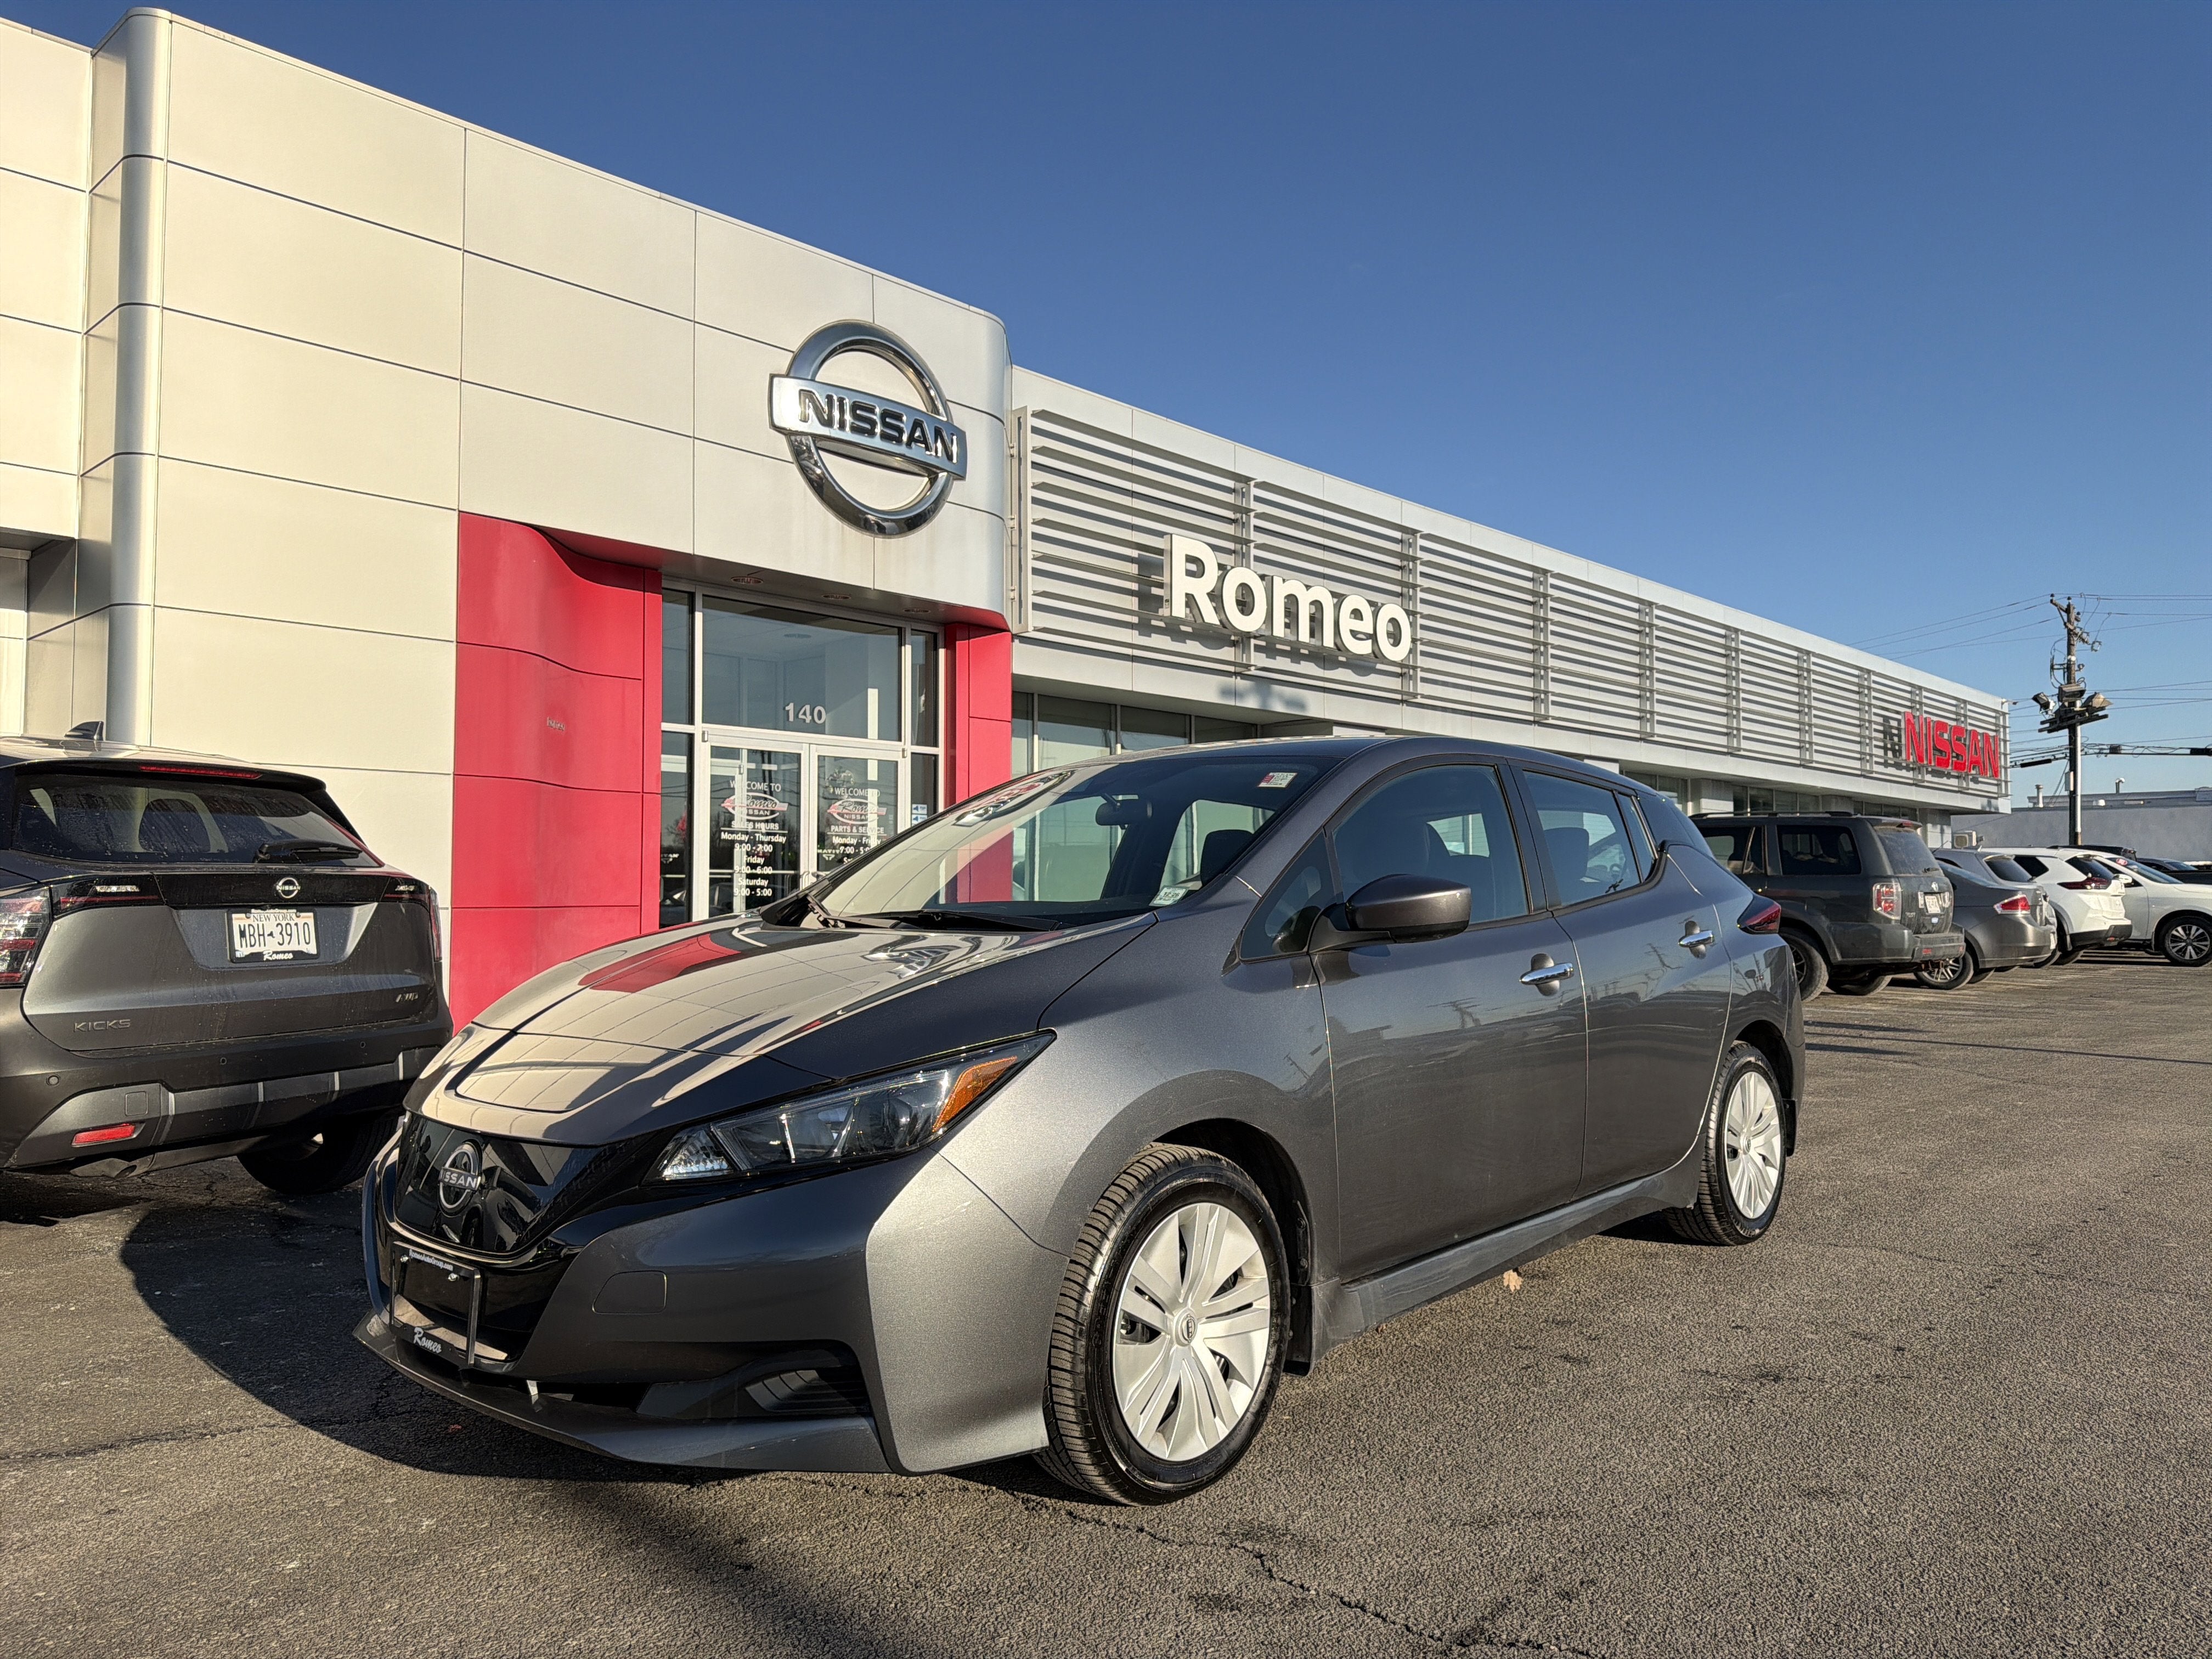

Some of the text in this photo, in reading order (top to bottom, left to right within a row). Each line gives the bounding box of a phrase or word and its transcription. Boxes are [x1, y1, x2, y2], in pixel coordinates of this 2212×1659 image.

[798, 389, 957, 465] NISSAN
[1165, 534, 1411, 661] Romeo
[785, 702, 826, 724] 140
[1905, 712, 2000, 779] NISSAN
[730, 780, 781, 792] WCOME TO
[834, 787, 868, 797] WELCOME
[755, 822, 779, 831] HOURS
[721, 831, 749, 842] Monday
[755, 833, 787, 844] Thursday
[832, 836, 857, 845] Monday
[734, 843, 751, 852] 9:00
[839, 846, 855, 854] 7:00
[860, 847, 870, 855] 5:0
[743, 855, 765, 865] Friday
[734, 865, 751, 874] 9:00
[757, 866, 773, 874] 6:00
[738, 878, 769, 887] Saturday
[733, 888, 751, 896] 9:00
[756, 888, 772, 896] 5:00
[252, 913, 295, 922] NEW YORK
[238, 922, 311, 949] MBH 3910
[263, 950, 294, 961] Romeo
[74, 1019, 131, 1032] KICKS
[442, 1169, 477, 1189] ISSAN
[409, 1249, 454, 1272] RomeoAutoGroup.com
[413, 1327, 442, 1354] Romeo
